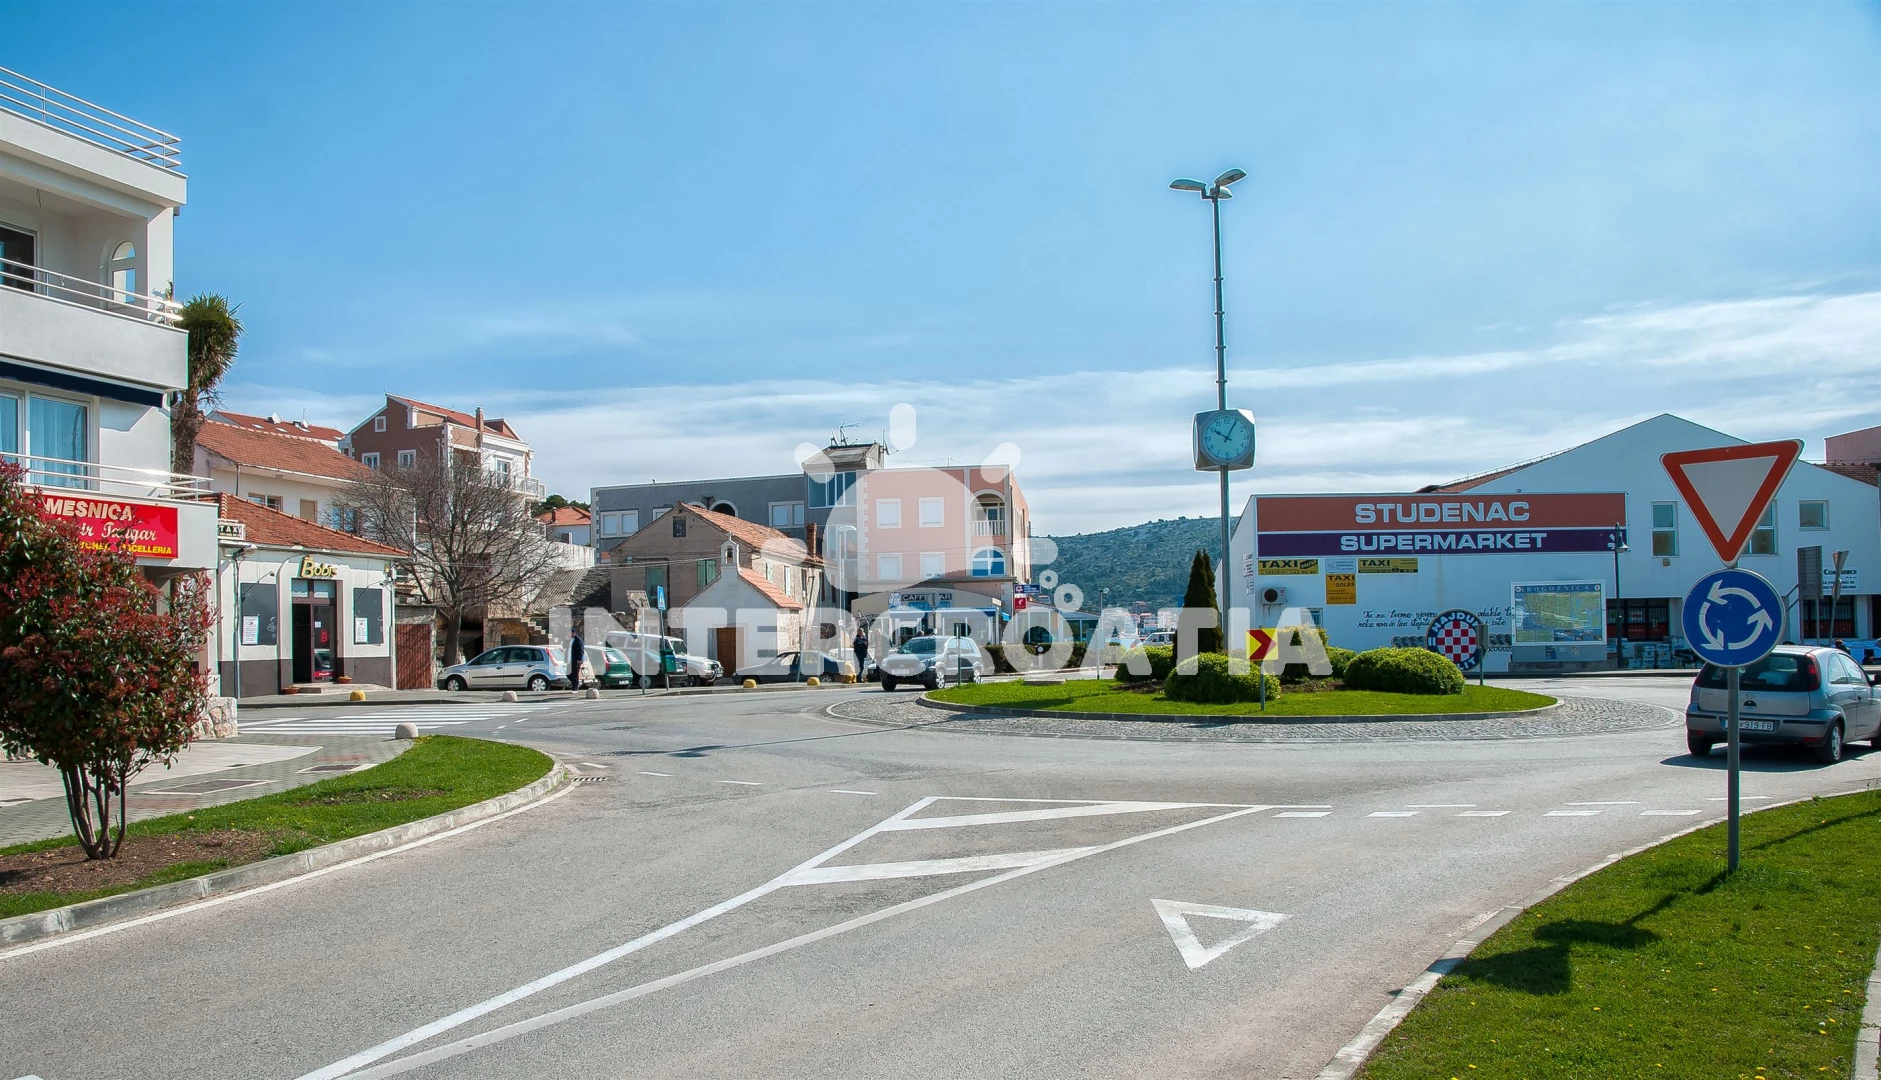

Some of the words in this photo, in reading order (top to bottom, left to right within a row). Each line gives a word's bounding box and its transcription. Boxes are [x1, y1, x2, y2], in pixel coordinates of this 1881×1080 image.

[45, 498, 133, 521] MESNICA
[1355, 502, 1530, 524] STUDENAC
[1340, 533, 1547, 551] SUPERMARKET
[1259, 560, 1298, 568] TAXI
[1360, 559, 1390, 567] TAXI
